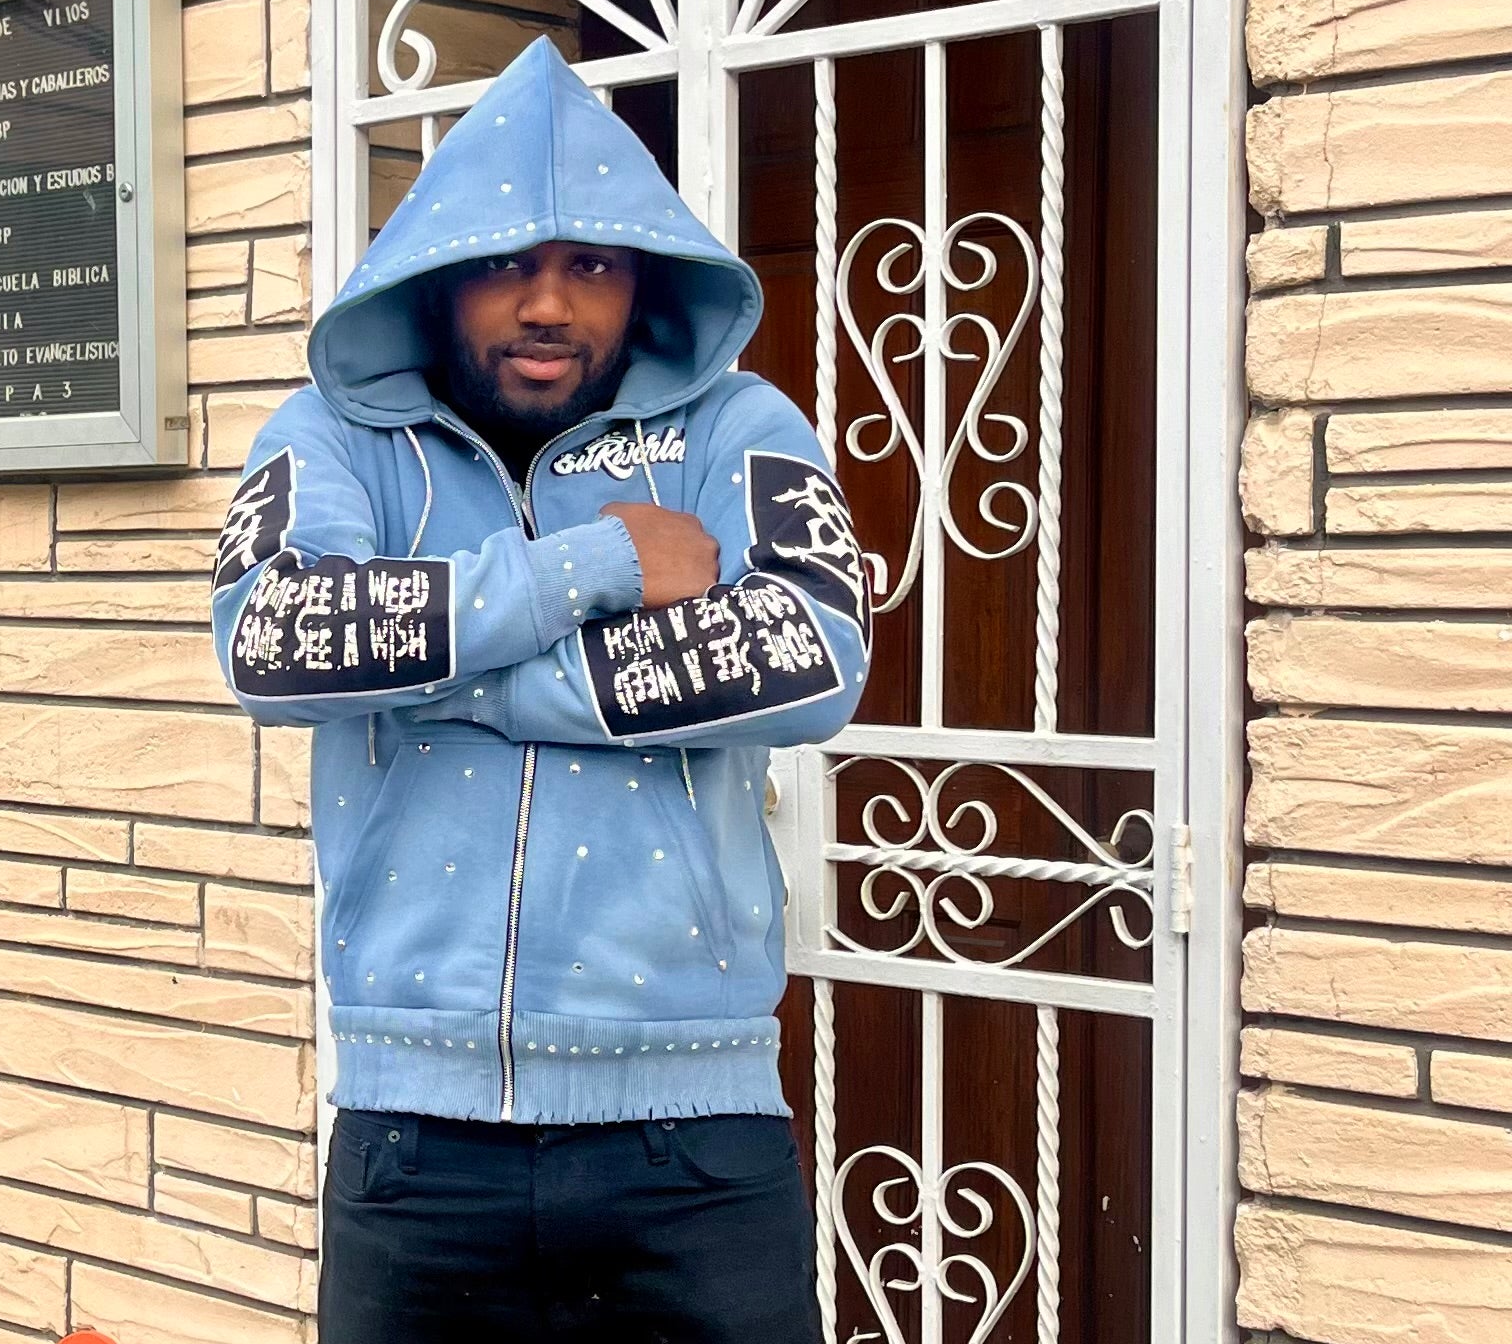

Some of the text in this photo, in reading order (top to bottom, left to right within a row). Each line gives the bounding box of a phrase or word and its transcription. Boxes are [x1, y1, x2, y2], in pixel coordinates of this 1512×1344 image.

[19, 79, 31, 97] Y
[31, 64, 110, 95] CABALLEROS
[34, 174, 44, 192] Y
[47, 165, 102, 190] ESTUDIOS
[52, 264, 110, 288] BIBLICA
[5, 385, 15, 402] P
[32, 383, 43, 401] A
